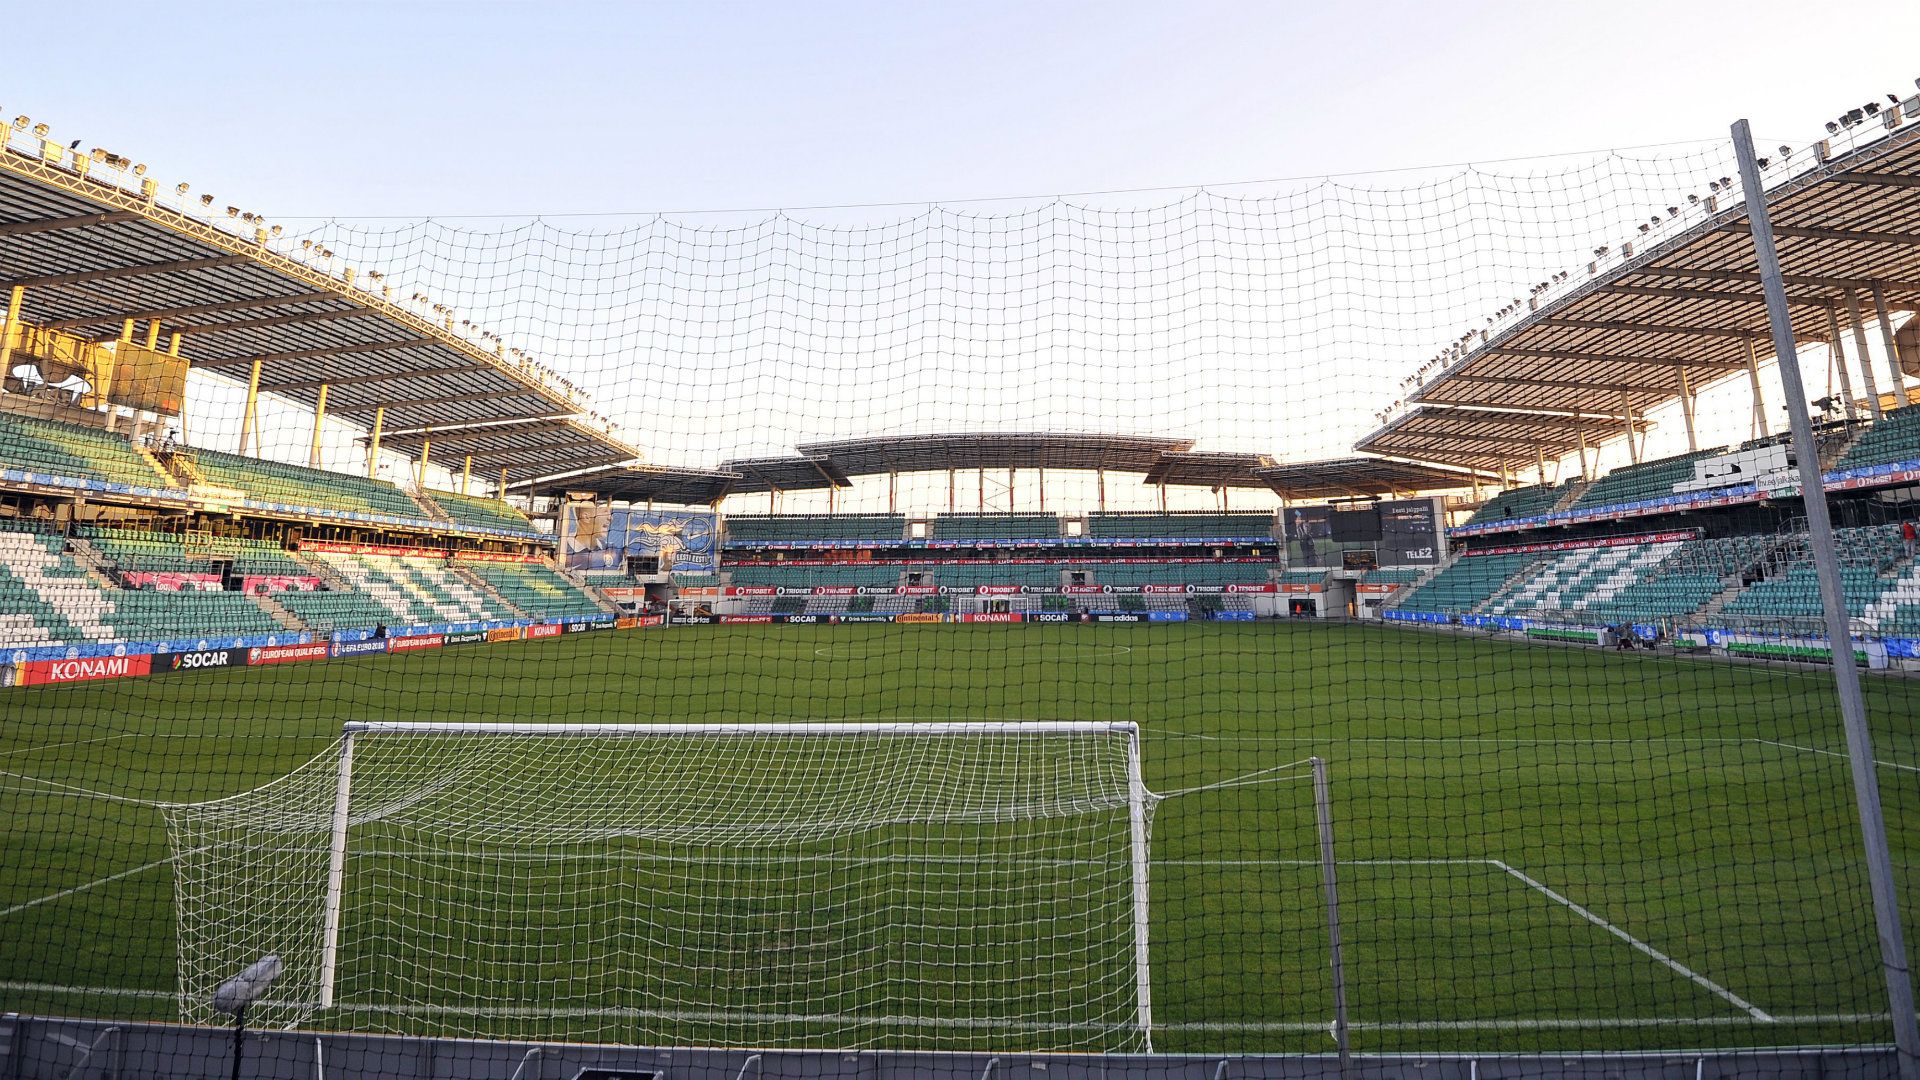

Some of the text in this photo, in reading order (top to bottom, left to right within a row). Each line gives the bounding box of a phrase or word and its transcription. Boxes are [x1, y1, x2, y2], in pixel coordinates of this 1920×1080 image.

[676, 553, 691, 561] EESTI
[1405, 547, 1433, 559] TELE2
[790, 615, 817, 623] SOCAR
[896, 614, 934, 622] Continental
[974, 614, 1011, 622] KONAMI
[1040, 613, 1069, 622] SOCAR
[1114, 614, 1139, 622] adidas
[534, 625, 556, 637] KONAMI
[571, 623, 586, 632] SOCAR
[342, 641, 385, 652] UEFA EURO 2016
[396, 637, 442, 648] EUROPEAN QUALIFIERS
[262, 646, 326, 659] EUROPEAN QUALIFIERS
[182, 651, 228, 669] SOCAR
[51, 658, 129, 680] KONAMI
